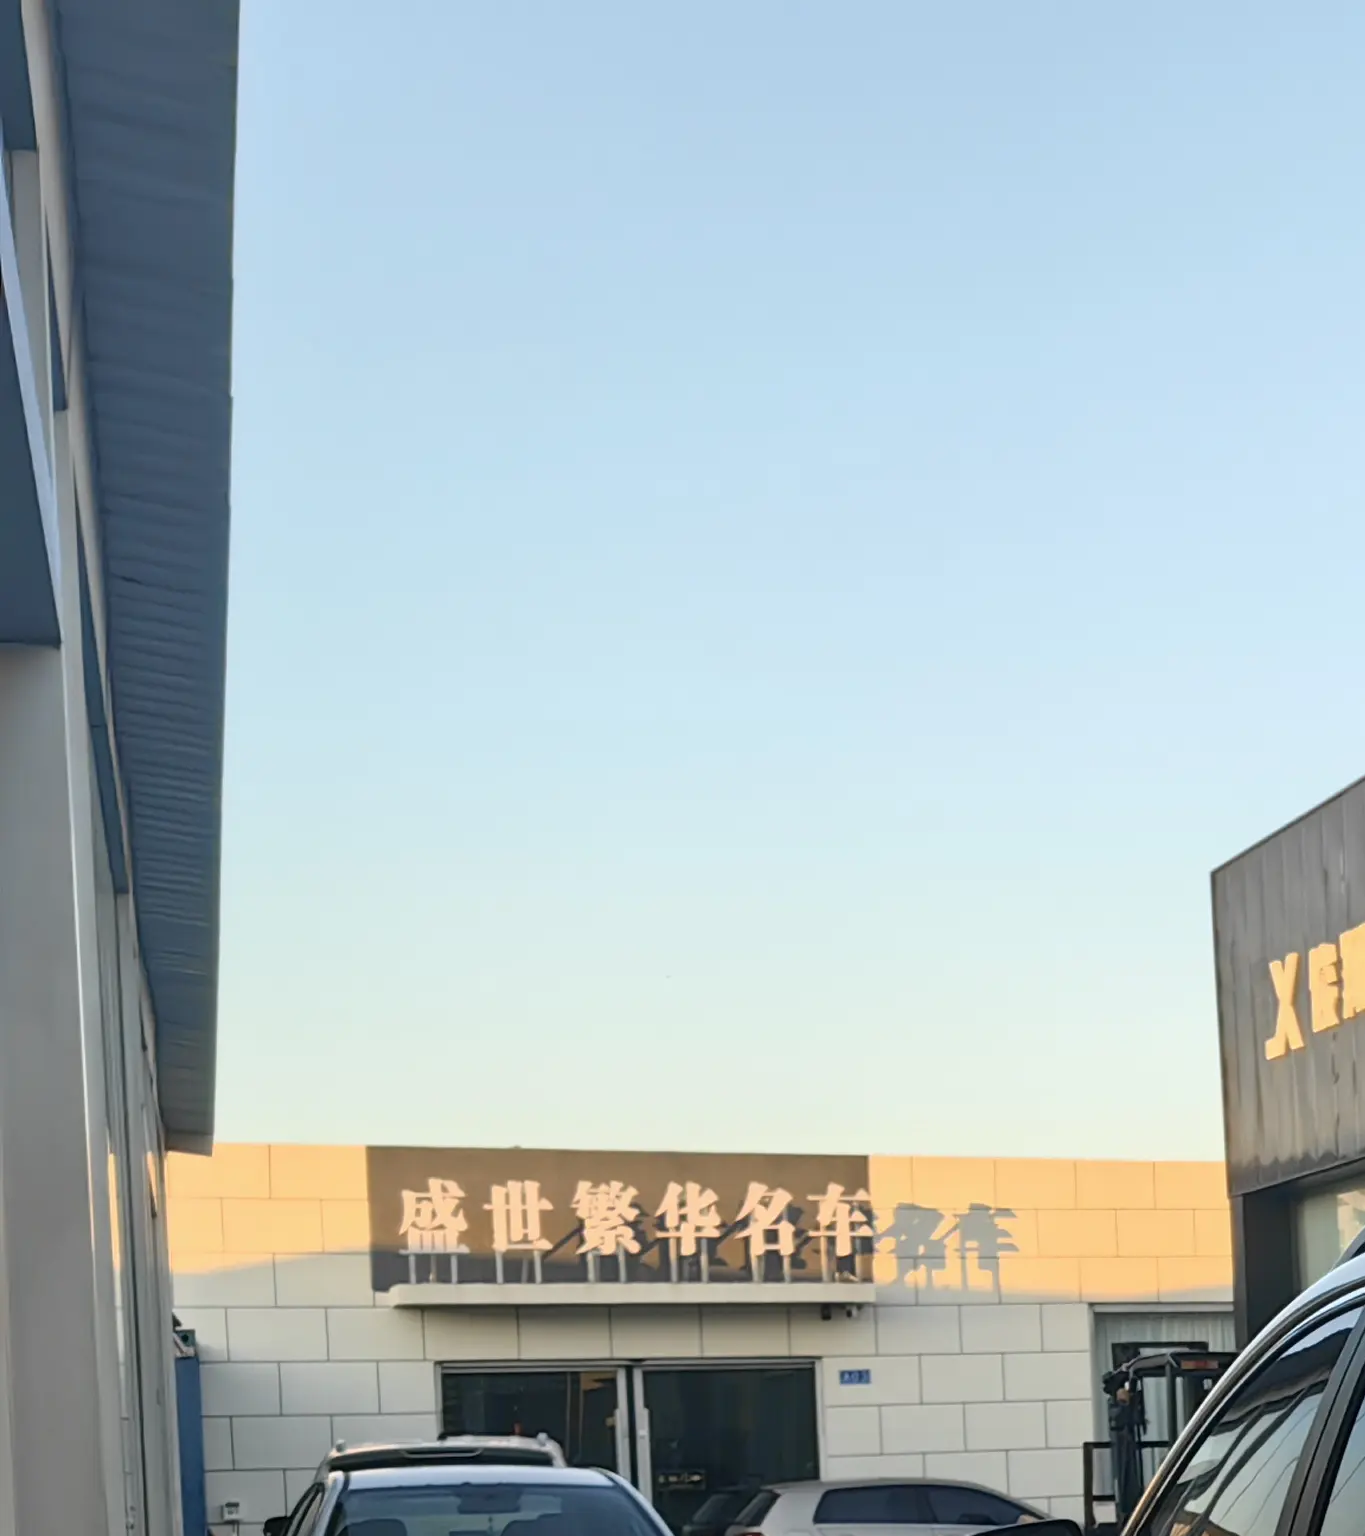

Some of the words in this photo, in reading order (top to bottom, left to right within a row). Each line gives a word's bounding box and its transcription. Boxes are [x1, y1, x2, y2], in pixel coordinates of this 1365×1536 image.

[399, 1177, 875, 1257] 盛世繁华名车
